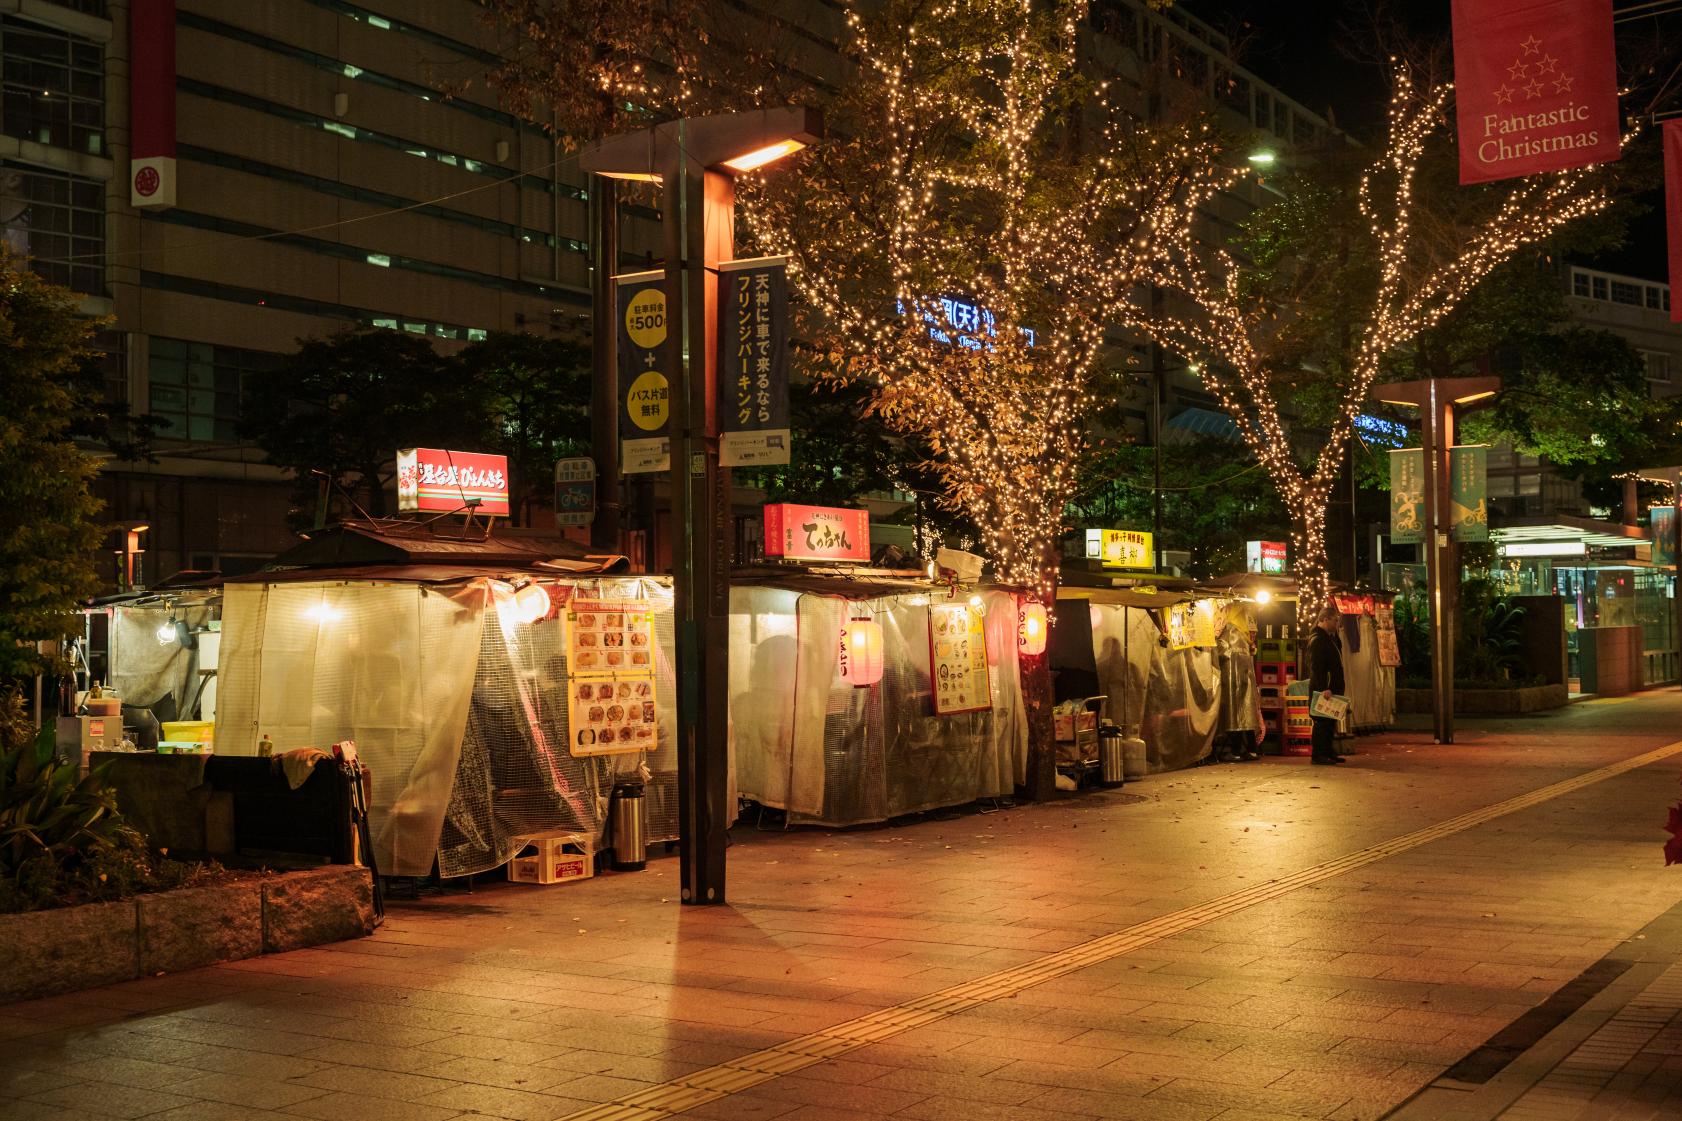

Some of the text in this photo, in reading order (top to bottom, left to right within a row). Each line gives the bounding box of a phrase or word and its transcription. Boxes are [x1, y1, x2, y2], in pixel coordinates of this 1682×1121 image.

[1483, 102, 1590, 137] Fantastic
[1478, 131, 1599, 164] Christmas
[737, 275, 753, 425] フリンジパーキング
[755, 274, 770, 422] 天神に車で来るなら
[632, 388, 668, 401] バス片道
[640, 404, 660, 417] 無料
[802, 522, 852, 551] てっちゃん
[556, 861, 582, 871] アサヒビール
